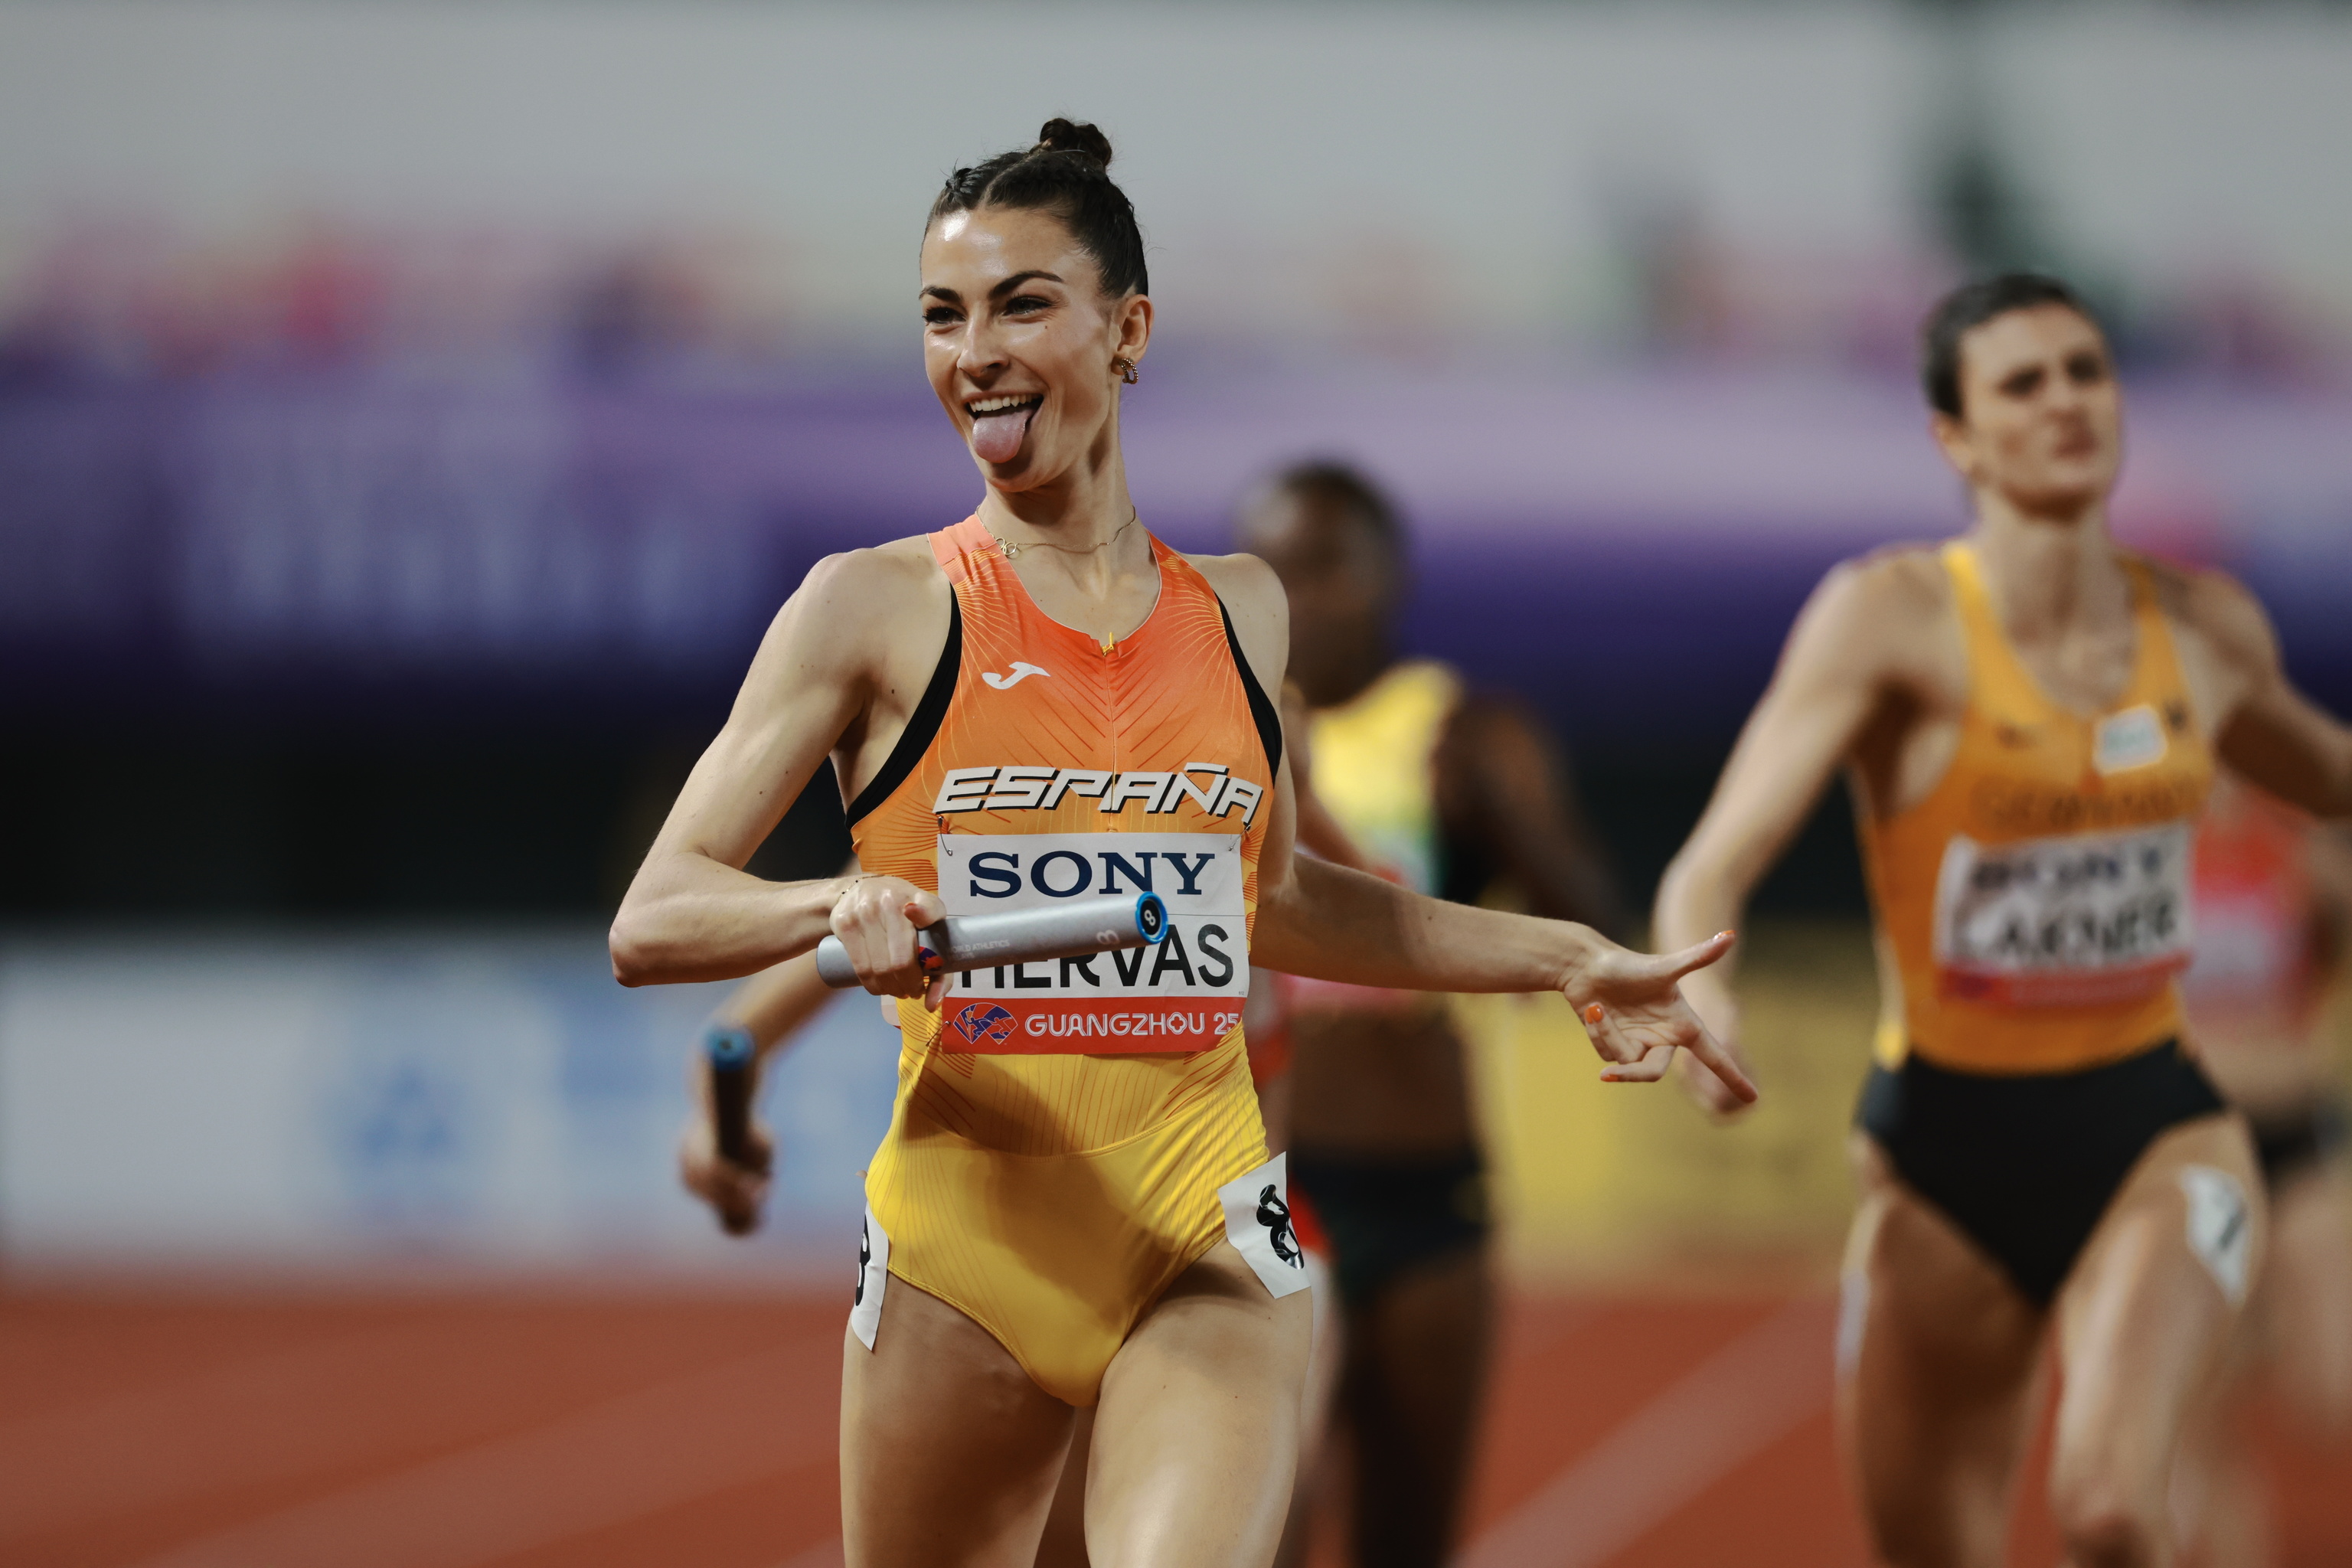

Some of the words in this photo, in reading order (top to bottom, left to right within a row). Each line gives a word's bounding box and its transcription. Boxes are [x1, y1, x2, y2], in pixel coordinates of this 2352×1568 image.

[932, 762, 1264, 825] ESPAÑA
[968, 851, 1216, 898] SONY
[1144, 910, 1156, 926] 8
[972, 939, 1011, 950] ATHLETICS
[1024, 1011, 1205, 1037] GUANGZHOU
[1256, 1184, 1305, 1269] 8
